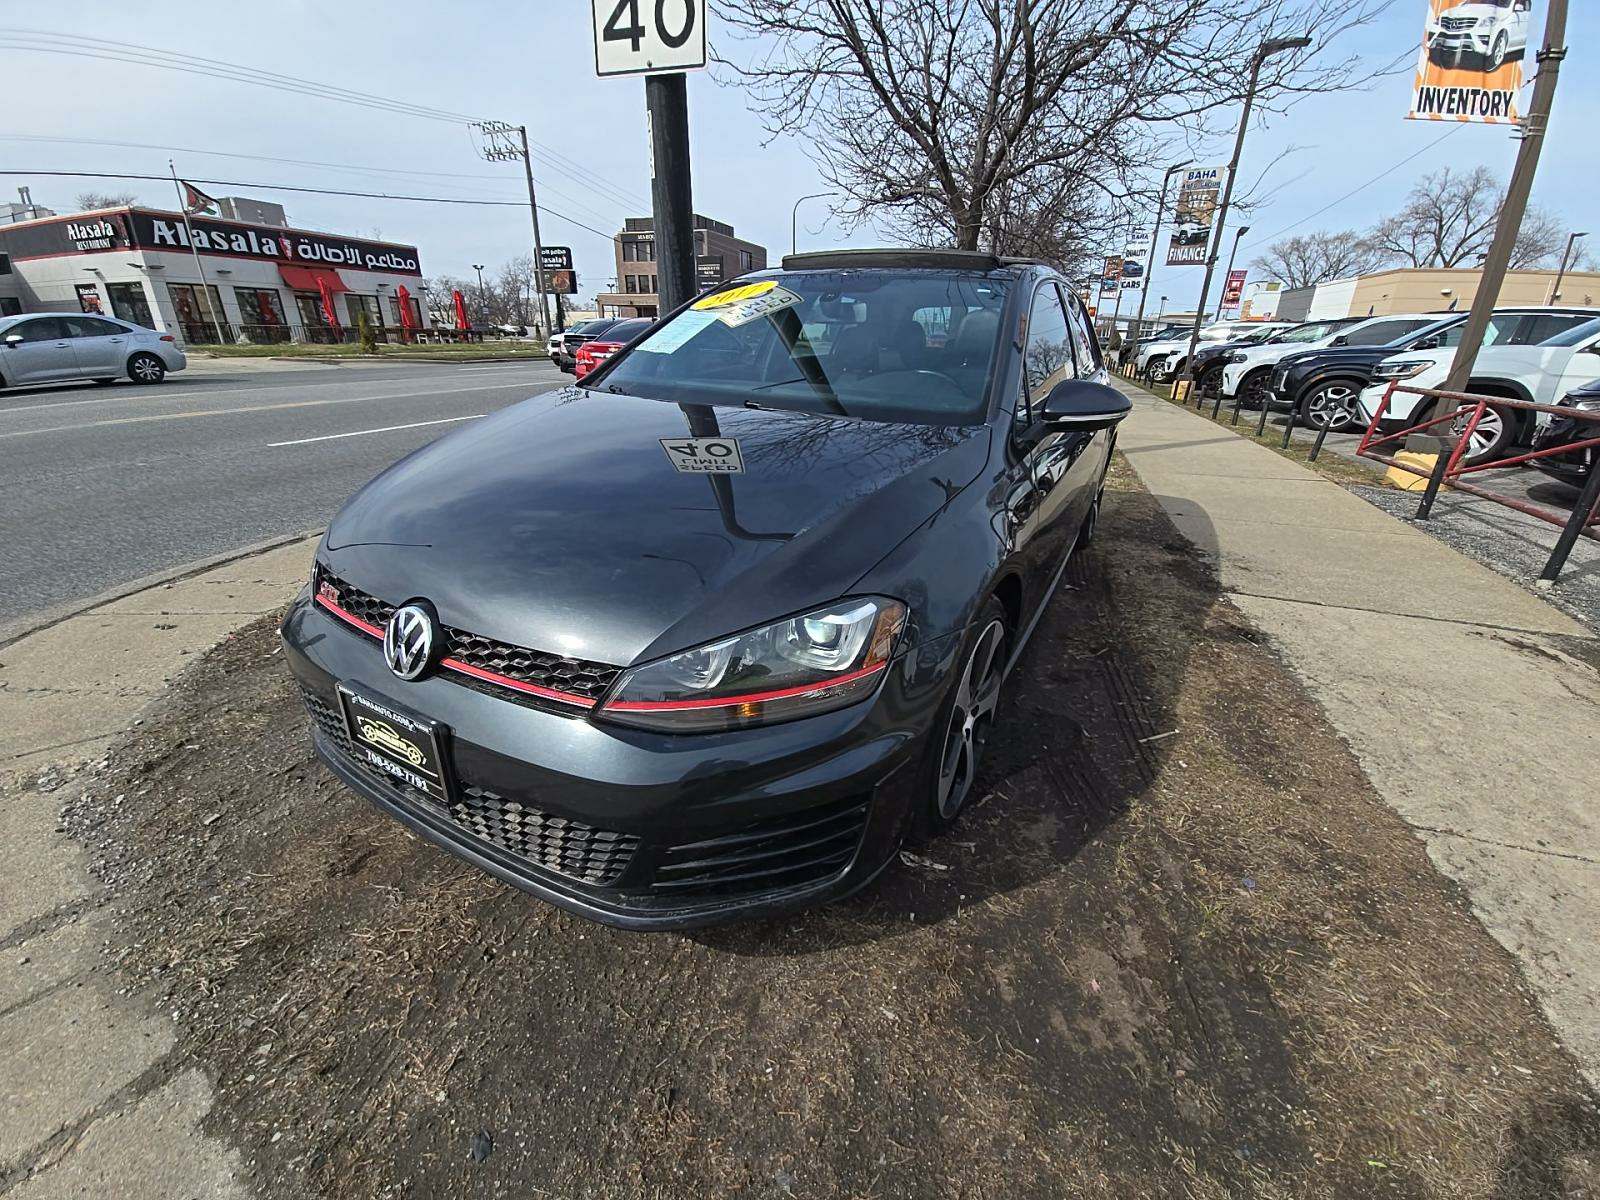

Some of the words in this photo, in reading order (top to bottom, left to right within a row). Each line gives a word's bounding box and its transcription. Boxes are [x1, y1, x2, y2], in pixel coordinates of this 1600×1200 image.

[603, 0, 696, 52] 40
[1416, 86, 1514, 117] INVENTORY
[1188, 170, 1217, 180] BAHA
[66, 220, 115, 241] Alasala
[152, 219, 279, 257] Alasala
[365, 253, 417, 270] مطاعم
[1126, 249, 1148, 257] QUALITY
[1168, 247, 1206, 261] FINANCE
[1121, 280, 1141, 289] CARS
